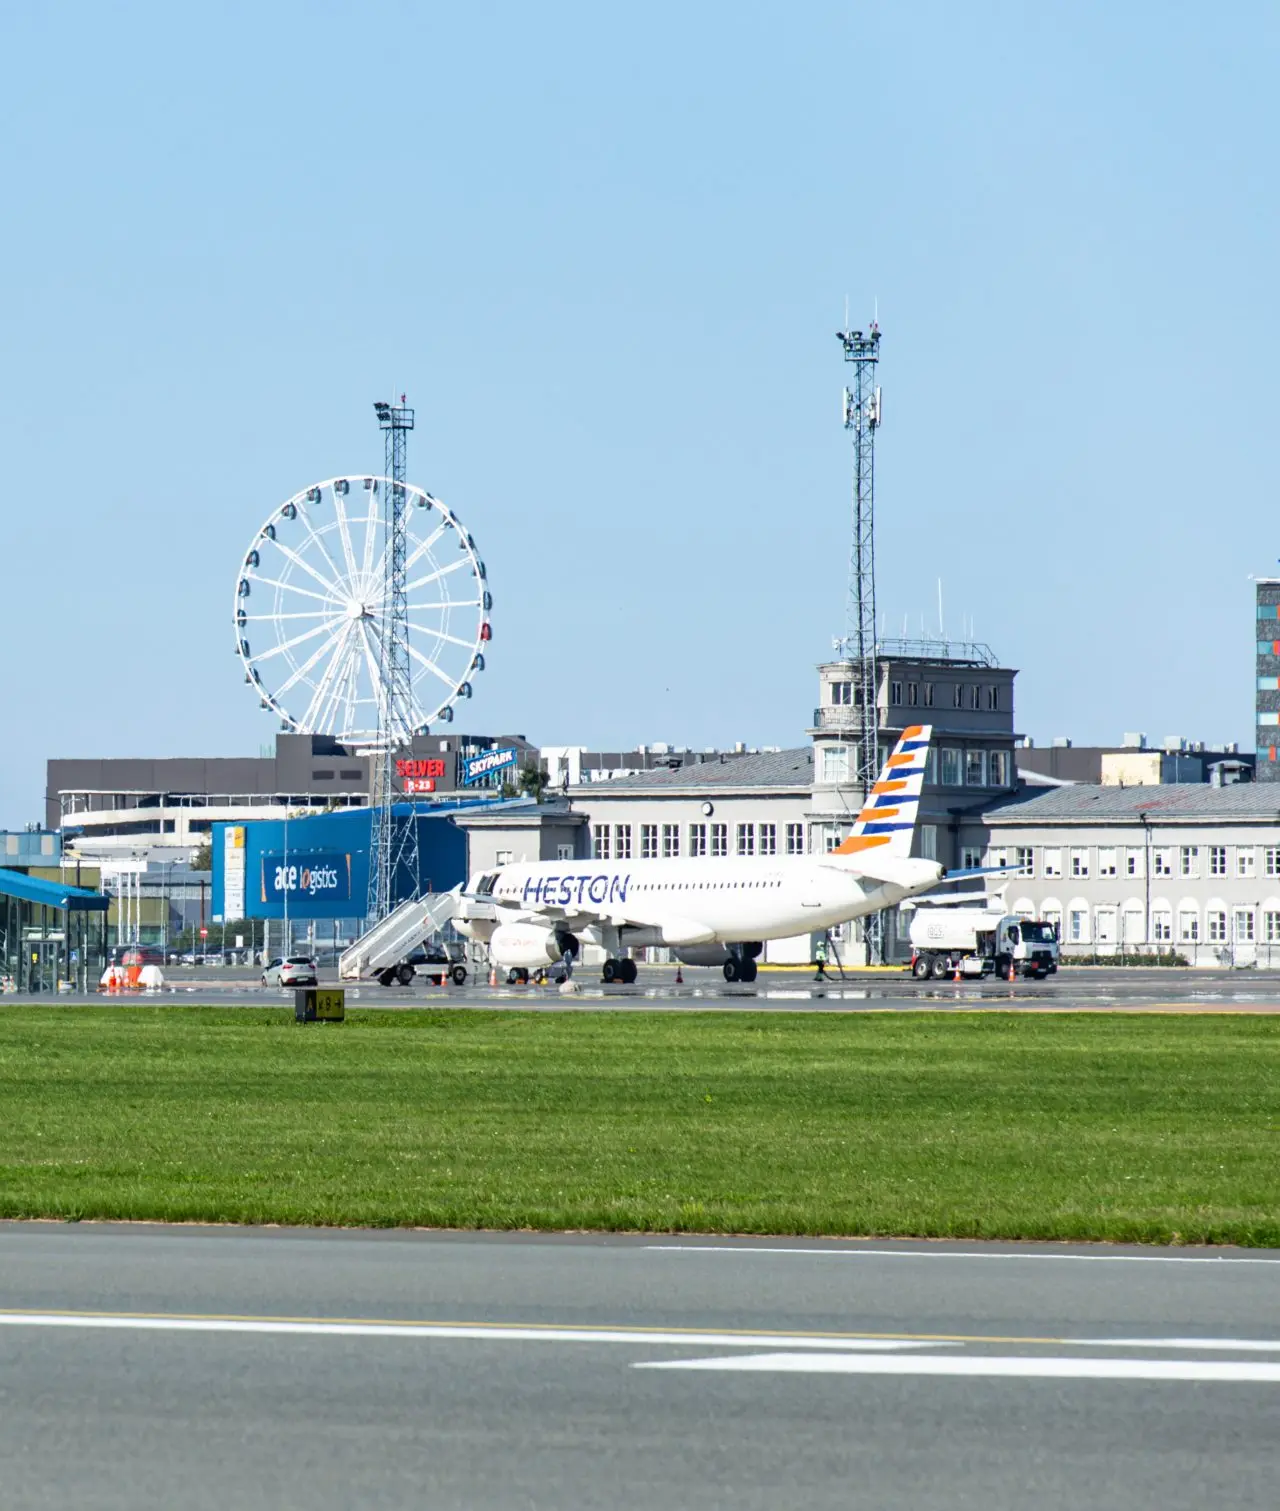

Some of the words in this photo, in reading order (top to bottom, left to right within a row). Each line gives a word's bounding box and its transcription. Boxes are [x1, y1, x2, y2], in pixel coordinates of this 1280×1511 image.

[396, 759, 445, 777] SELVER
[469, 751, 513, 777] SKYPARK
[274, 865, 297, 890] ace
[299, 864, 338, 895] logistics
[523, 874, 631, 905] HESTON
